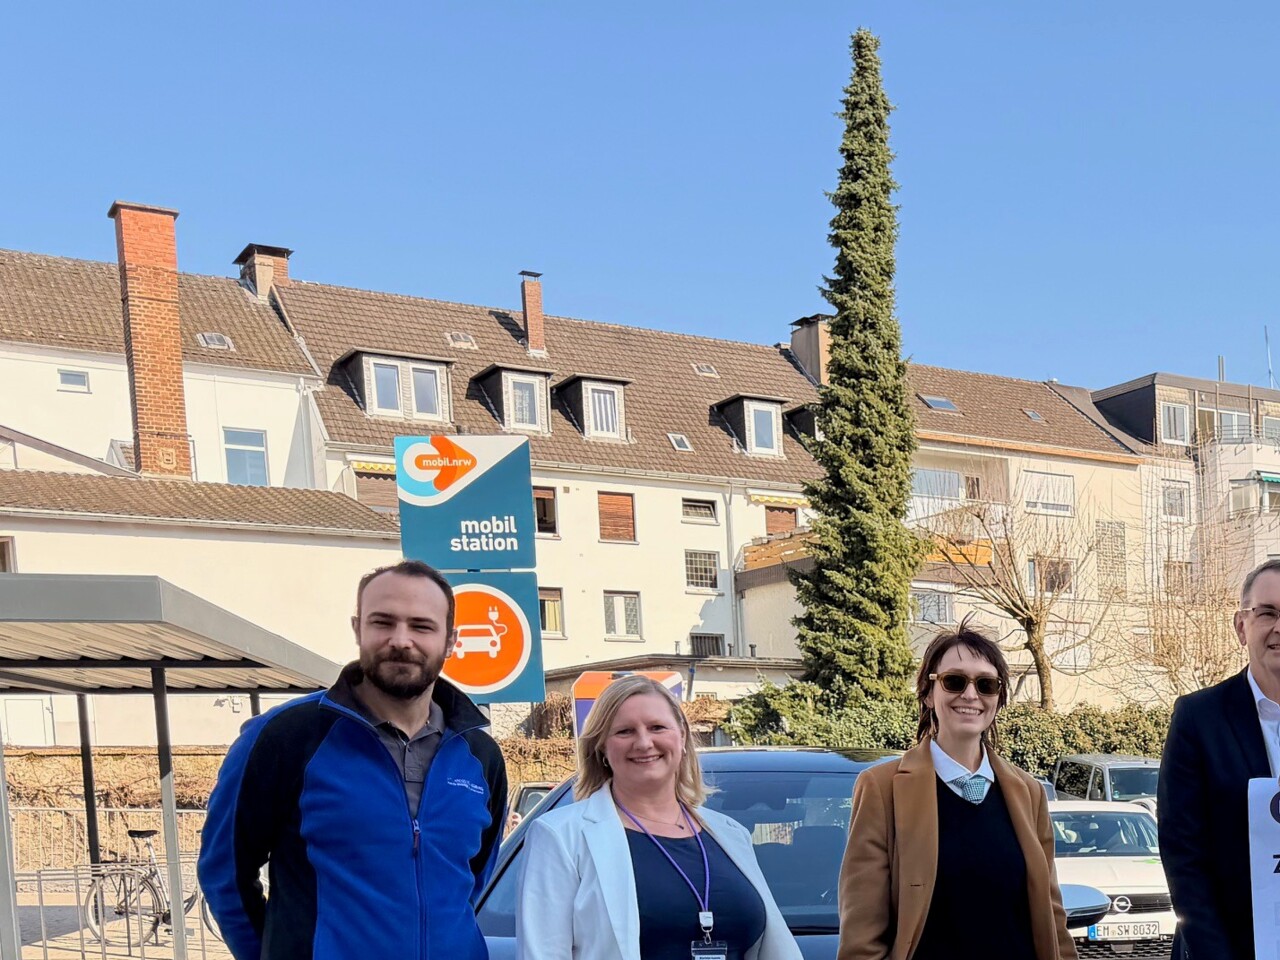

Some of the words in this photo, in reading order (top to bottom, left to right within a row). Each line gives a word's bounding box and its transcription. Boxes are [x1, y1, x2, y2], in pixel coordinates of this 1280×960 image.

[422, 457, 472, 467] mobil.nrw
[460, 516, 517, 534] mobil
[450, 534, 519, 552] station
[1096, 925, 1109, 937] EM
[1117, 925, 1130, 936] SW
[1133, 924, 1158, 935] 8032
